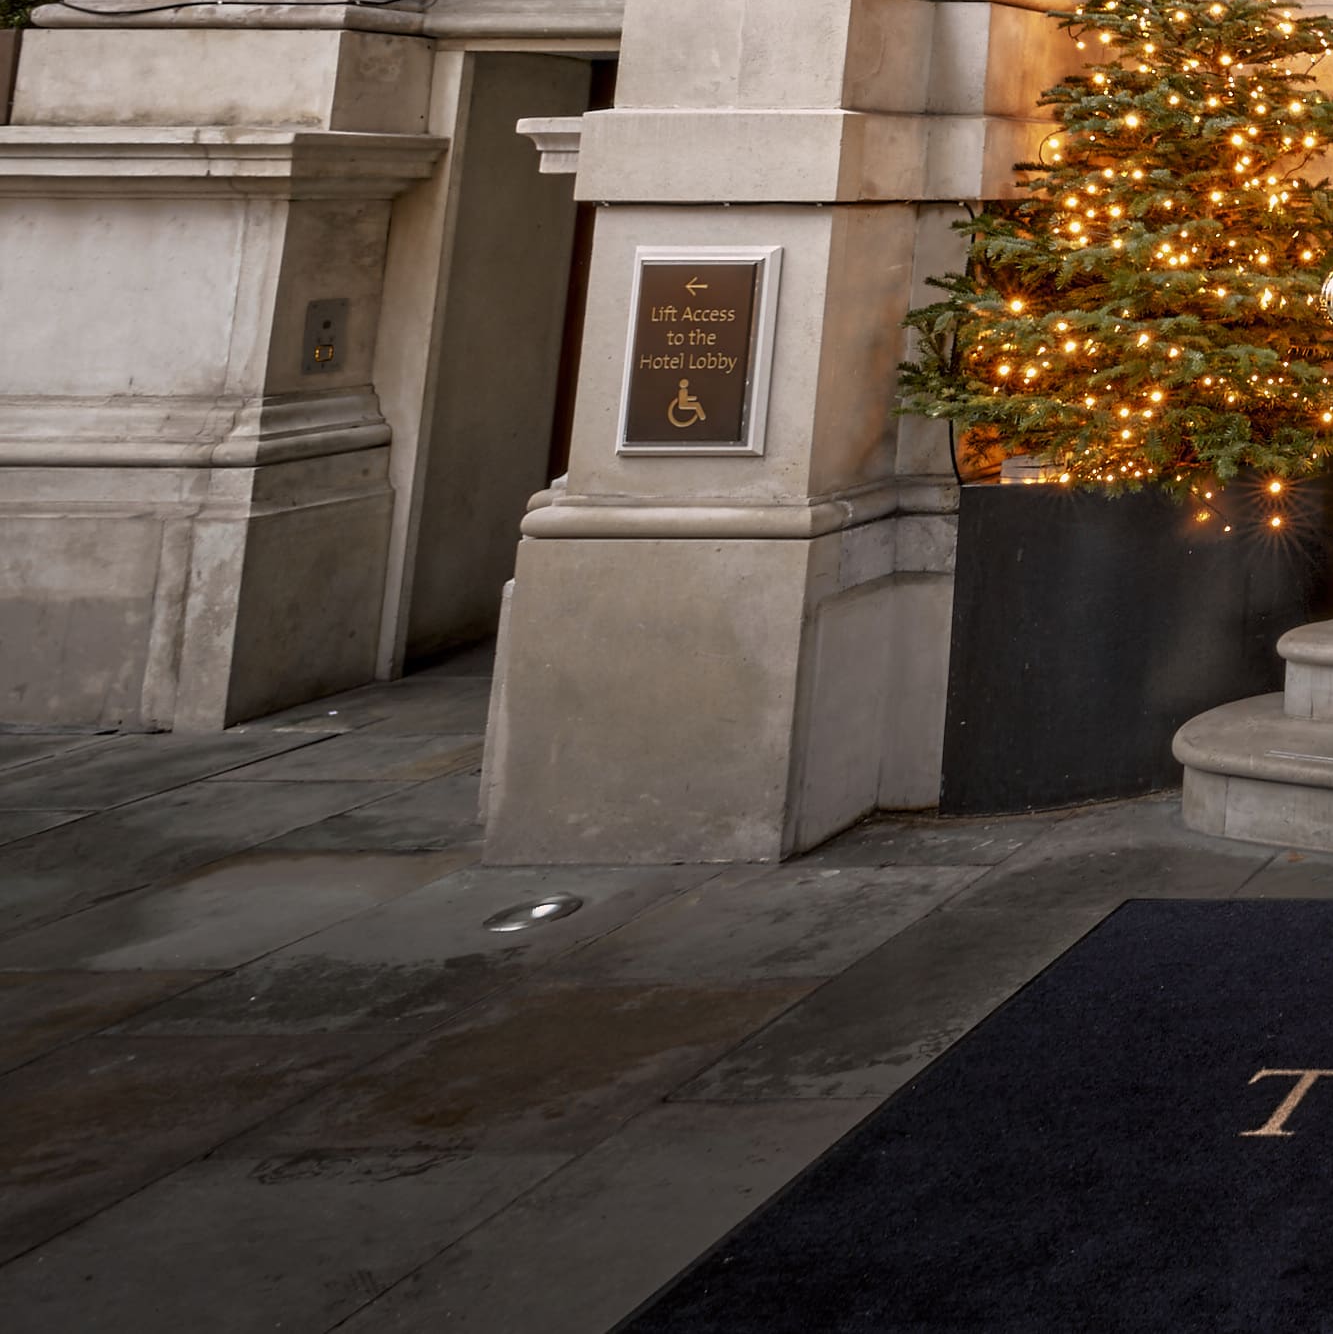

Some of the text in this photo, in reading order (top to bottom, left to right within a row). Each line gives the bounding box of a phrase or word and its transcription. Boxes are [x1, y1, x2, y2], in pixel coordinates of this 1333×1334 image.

[651, 305, 736, 322] Lift Access
[667, 329, 717, 346] to the
[640, 353, 738, 374] Hotel Lobby
